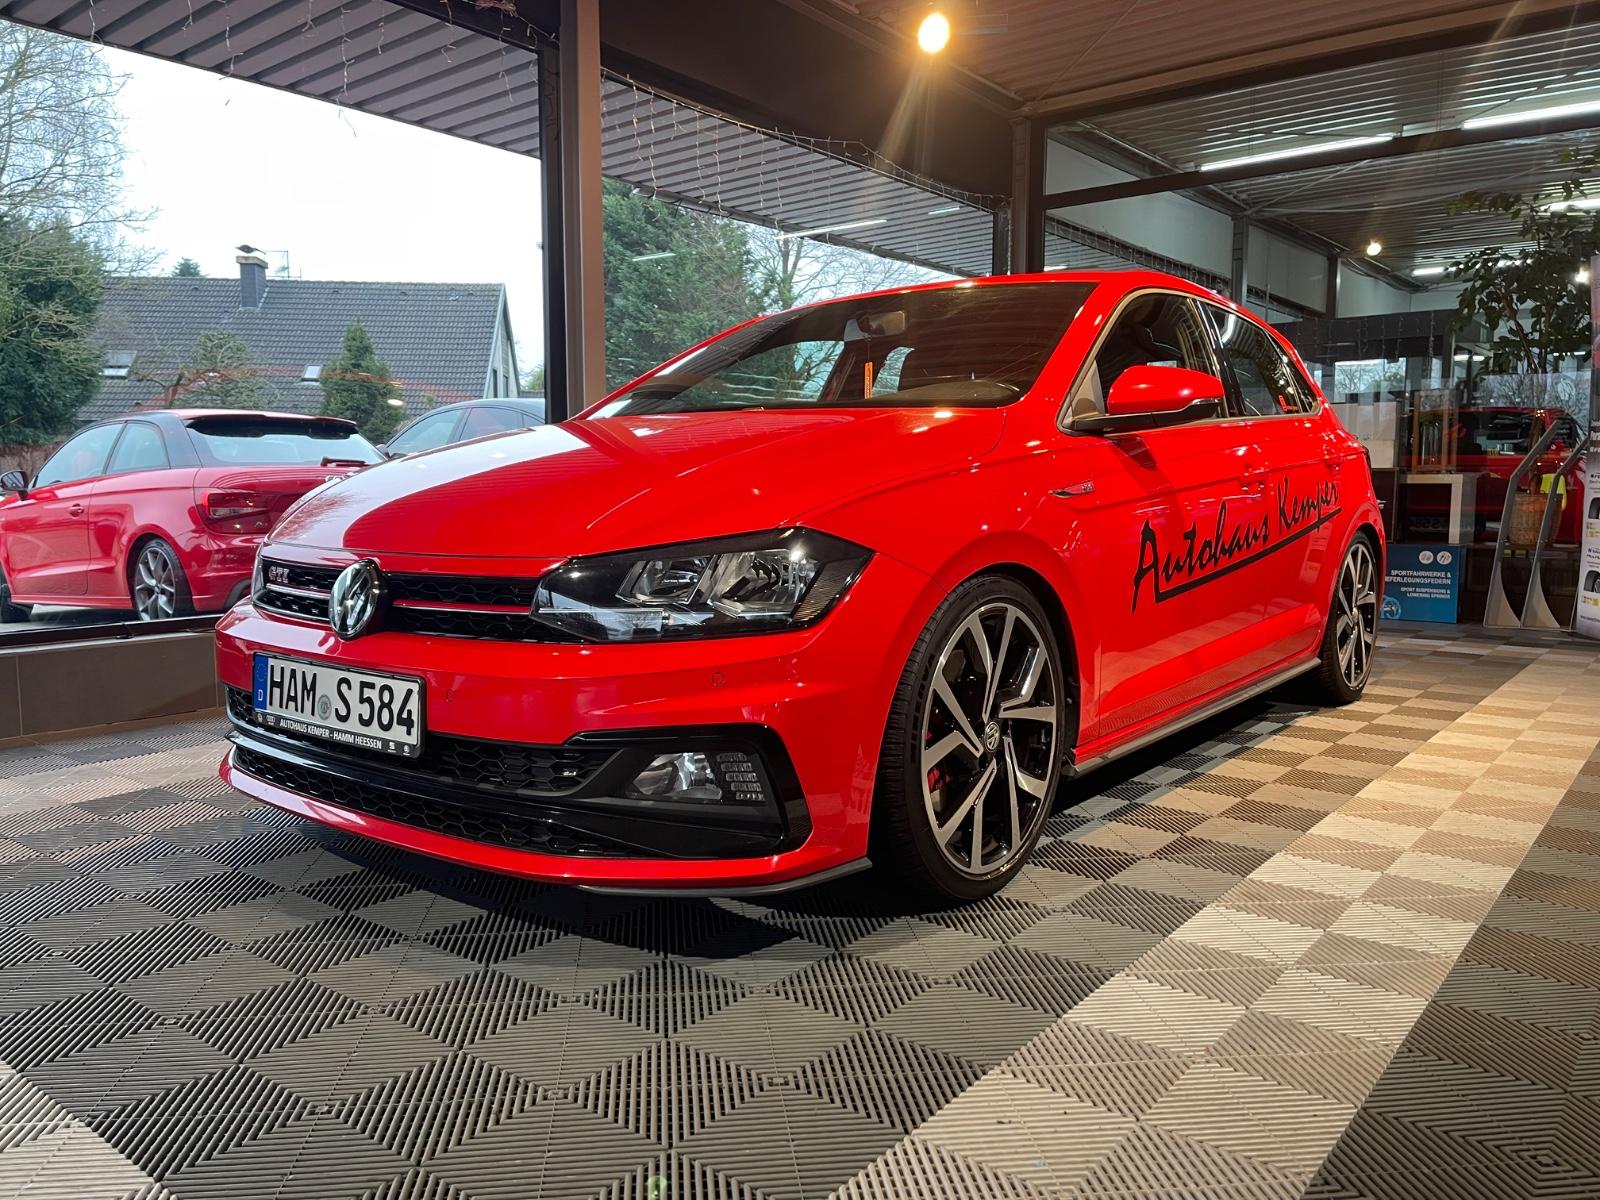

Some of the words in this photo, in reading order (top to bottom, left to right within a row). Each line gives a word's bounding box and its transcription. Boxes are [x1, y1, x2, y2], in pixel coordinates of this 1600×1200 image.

[1131, 501, 1271, 614] Autohaus
[1277, 475, 1339, 532] Kemper
[269, 566, 290, 583] GTI
[1385, 576, 1451, 585] IEFERLEGUNGSFEDERN
[1391, 570, 1446, 578] SPORTFAHRWERKE
[258, 689, 264, 701] D
[269, 664, 317, 717] HAM
[279, 718, 307, 733] AUTOHAUS
[307, 724, 330, 738] KEMPER
[333, 731, 355, 744] HAMM
[355, 735, 382, 749] HEESSEN
